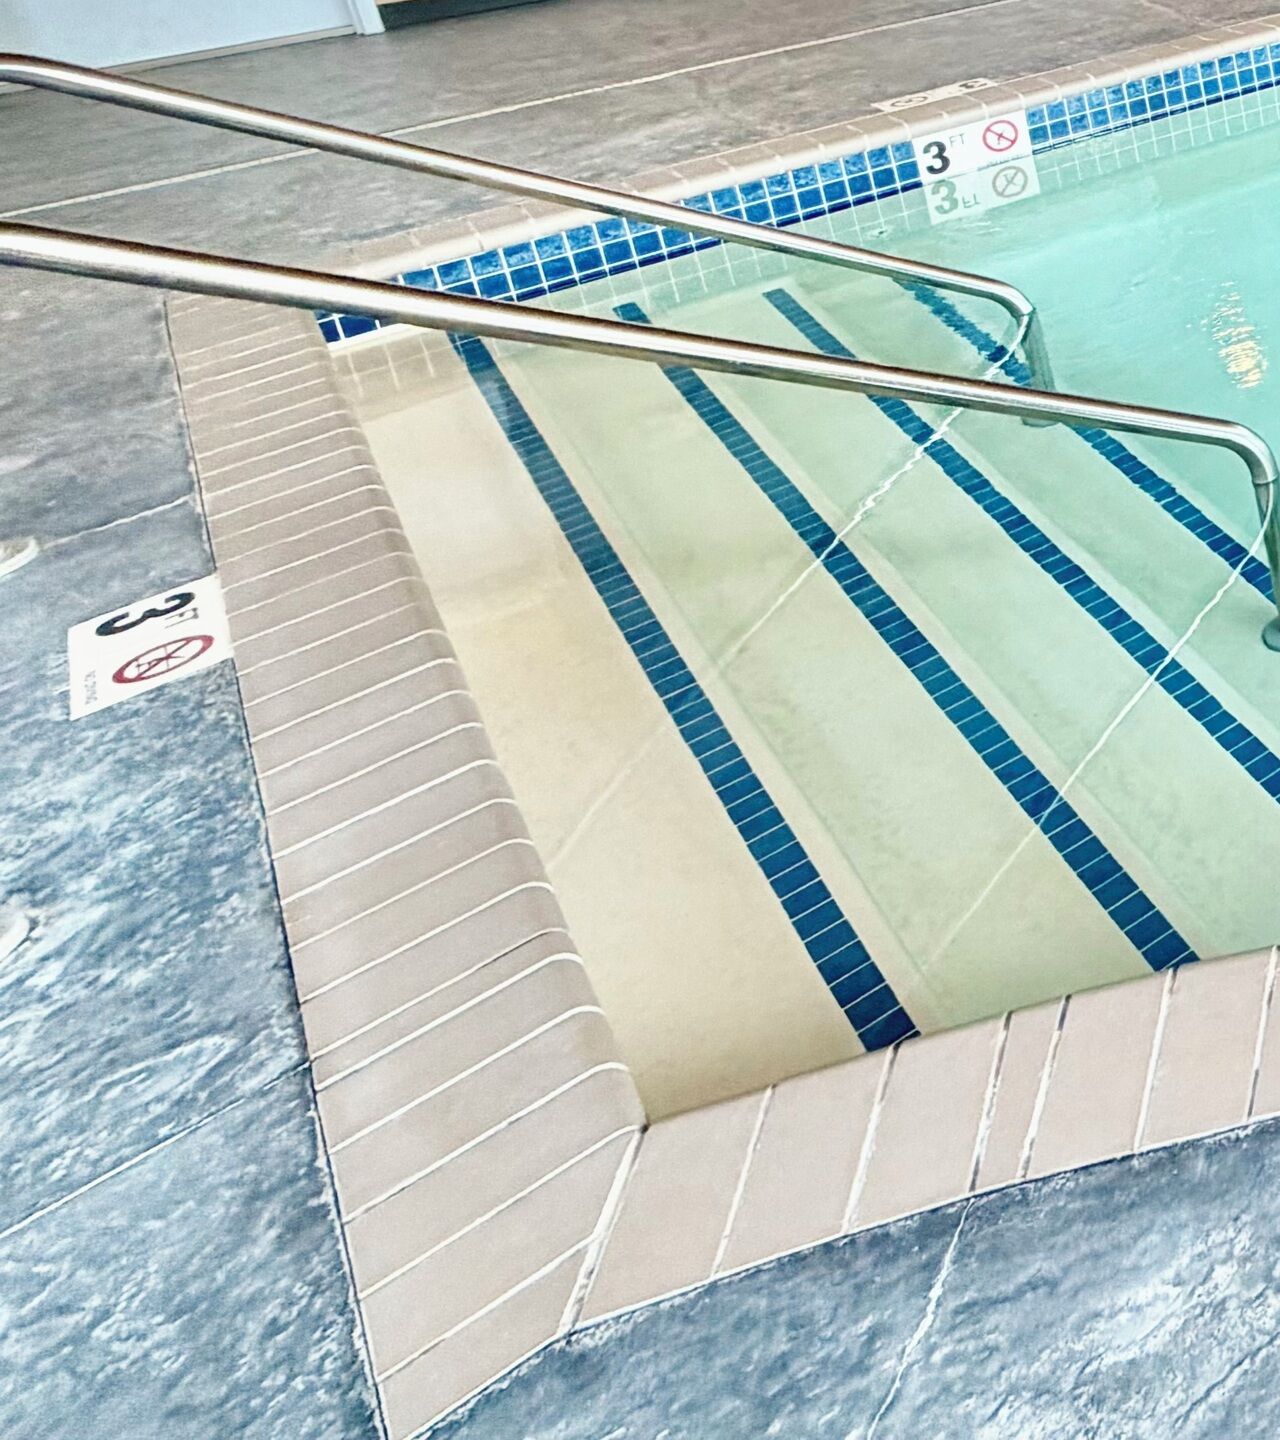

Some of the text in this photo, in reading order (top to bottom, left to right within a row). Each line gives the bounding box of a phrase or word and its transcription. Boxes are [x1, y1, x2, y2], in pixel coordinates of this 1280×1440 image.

[922, 140, 951, 175] 3
[949, 132, 966, 147] FT
[95, 592, 196, 637] 3
